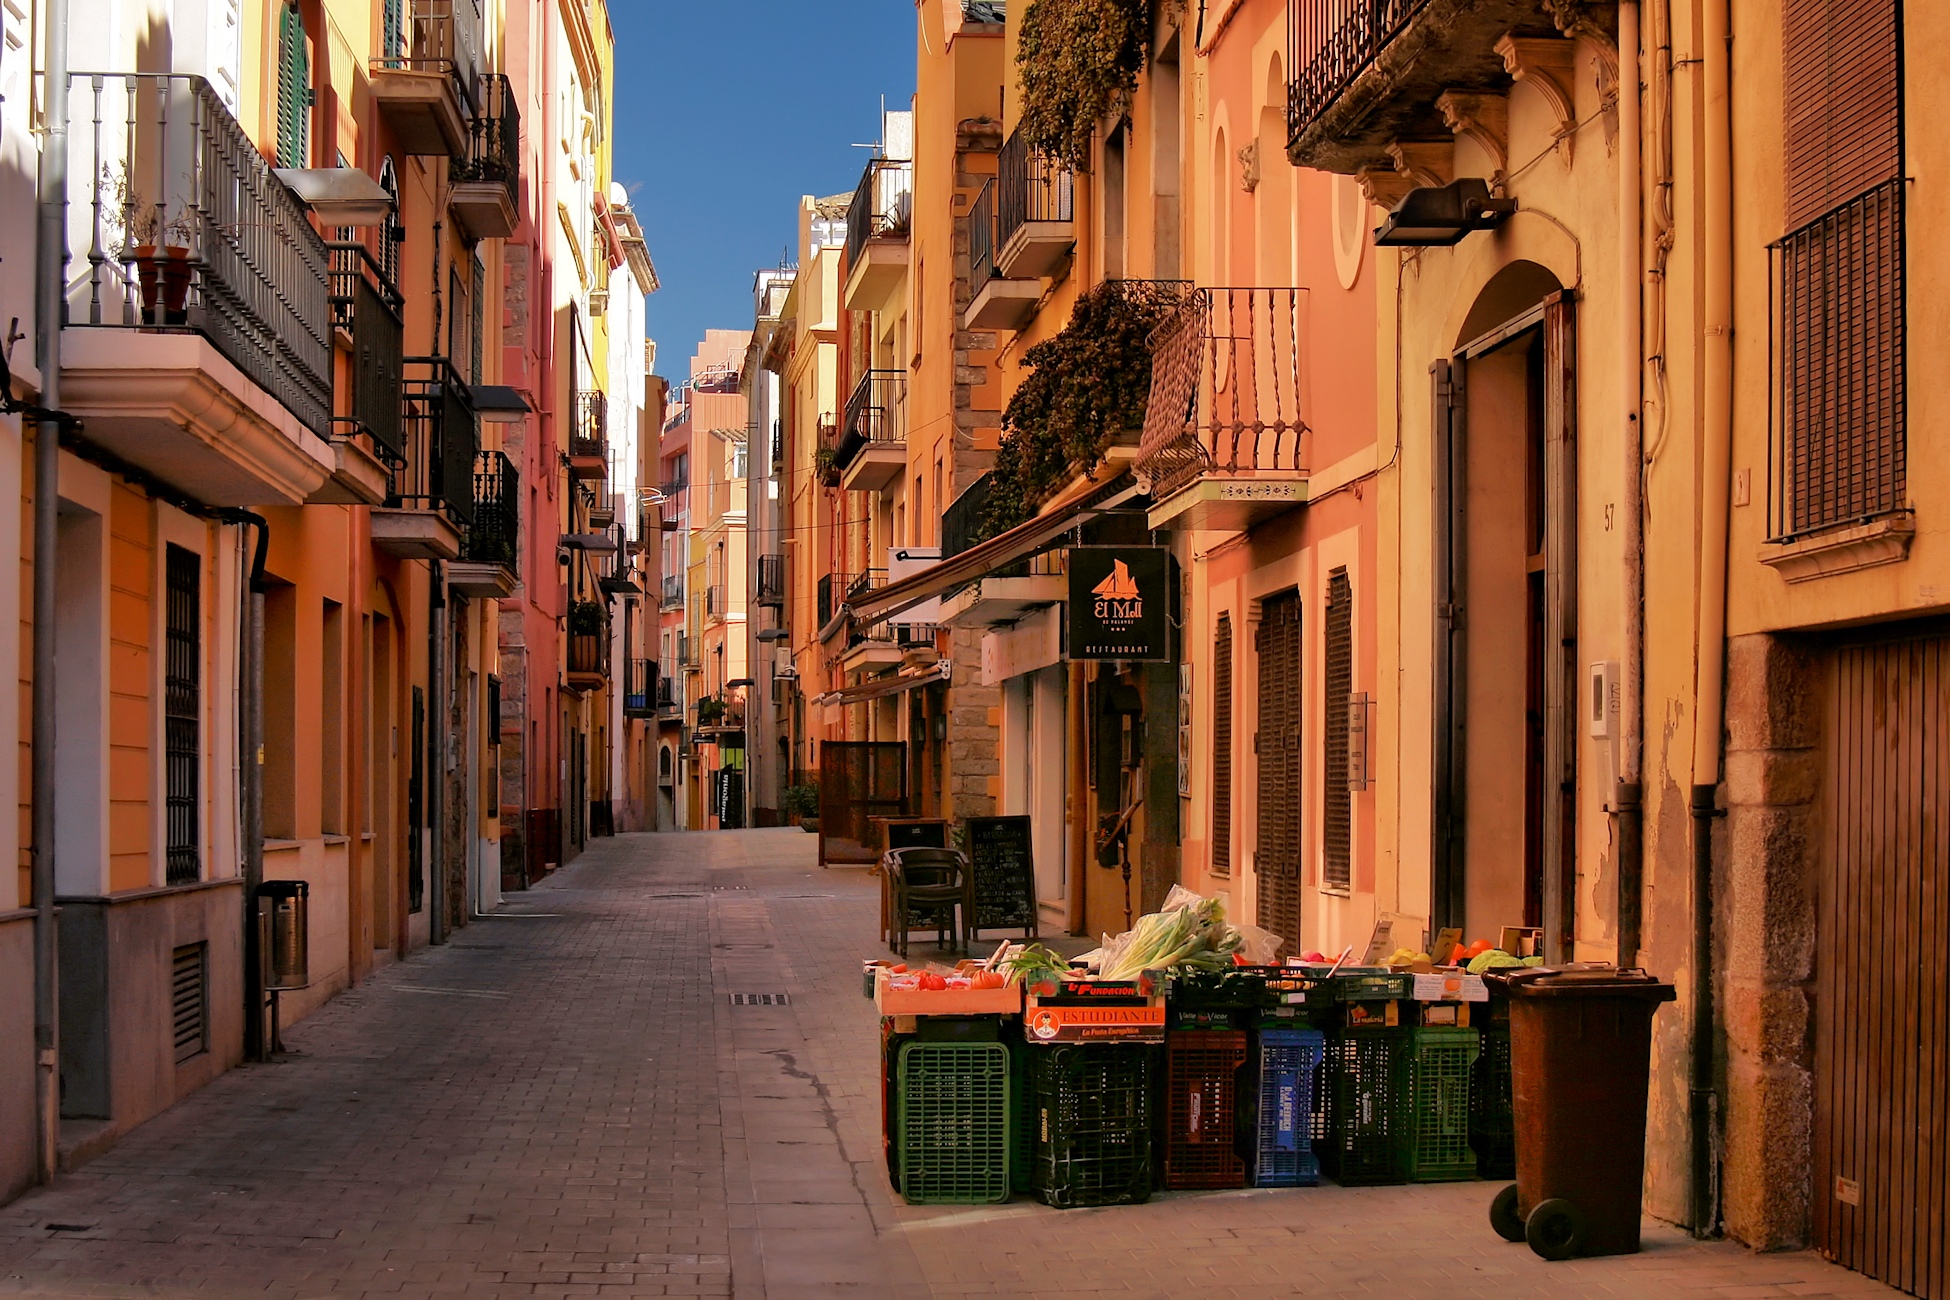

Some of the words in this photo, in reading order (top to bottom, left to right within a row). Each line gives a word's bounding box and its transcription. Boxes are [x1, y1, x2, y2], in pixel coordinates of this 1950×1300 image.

[1604, 503, 1615, 532] 57
[1094, 601, 1108, 618] El
[1112, 601, 1142, 618] Moll
[1085, 645, 1149, 654] RESTAURANT
[721, 774, 729, 822] patagonia
[1063, 1011, 1159, 1022] ESTUDIANTE
